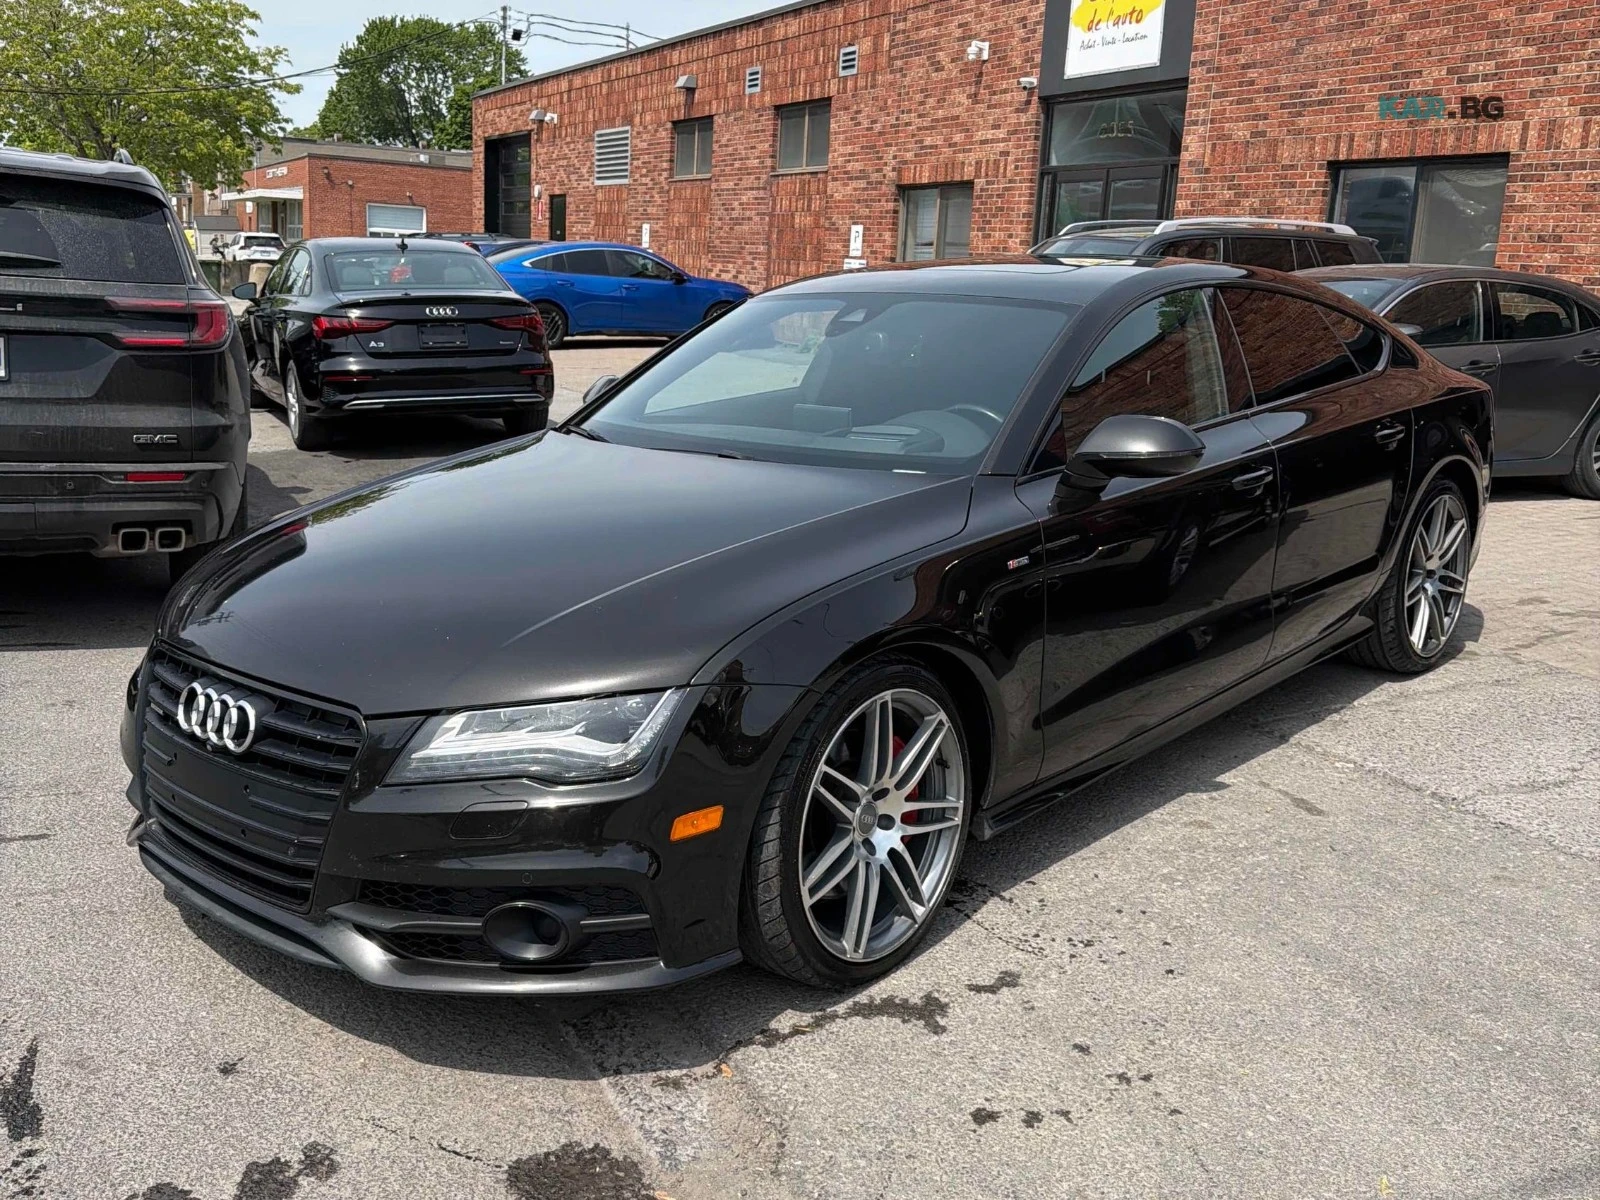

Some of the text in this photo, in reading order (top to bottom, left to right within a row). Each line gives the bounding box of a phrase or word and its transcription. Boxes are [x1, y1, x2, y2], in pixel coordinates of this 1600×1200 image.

[1088, 6, 1143, 33] de l'auto
[1122, 32, 1148, 44] Location
[369, 340, 385, 348] A3
[132, 434, 178, 444] GMC
